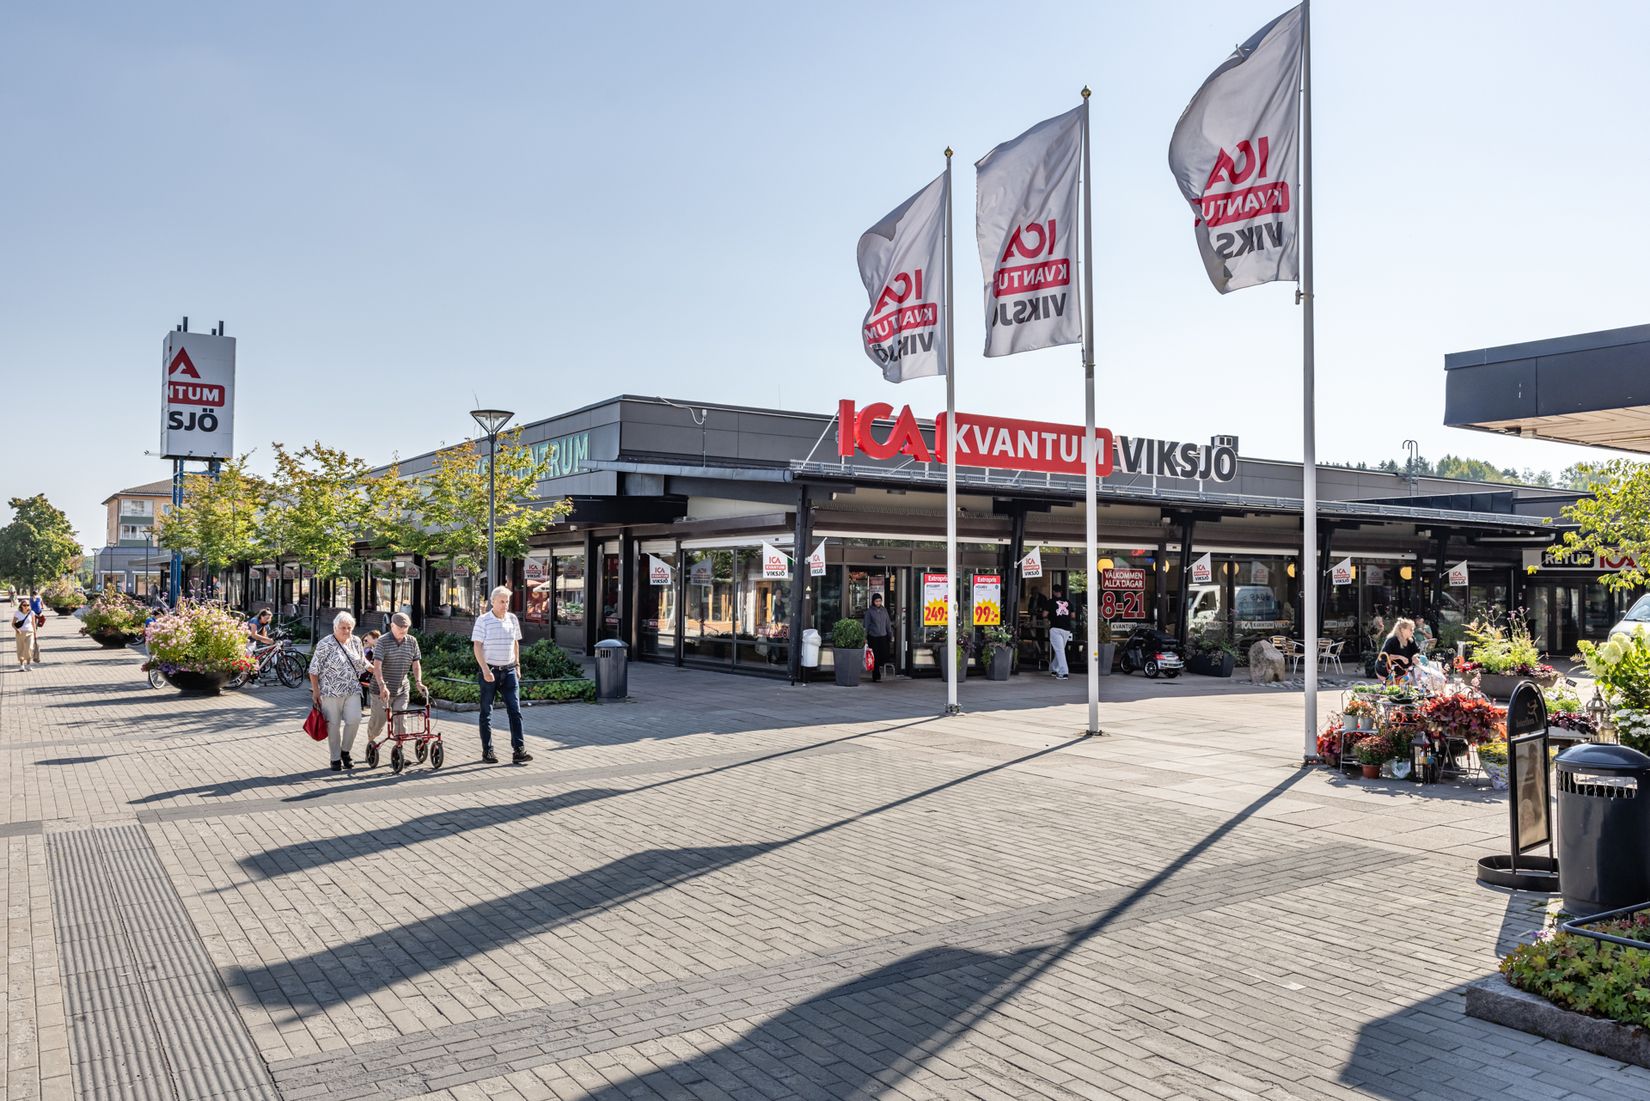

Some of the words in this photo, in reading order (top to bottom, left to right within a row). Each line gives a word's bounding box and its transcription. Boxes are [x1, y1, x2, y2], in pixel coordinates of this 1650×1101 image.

[168, 407, 219, 432] SJÖ
[838, 398, 932, 463] ICA
[953, 423, 1106, 465] KVANTUM
[1113, 434, 1240, 483] VIKSJÖ
[768, 556, 781, 564] ICA
[1104, 570, 1143, 580] VÄLKOMMEN
[1104, 580, 1121, 588] ALLA
[1121, 580, 1144, 588] DAGAR
[1101, 591, 1146, 619] 8-21
